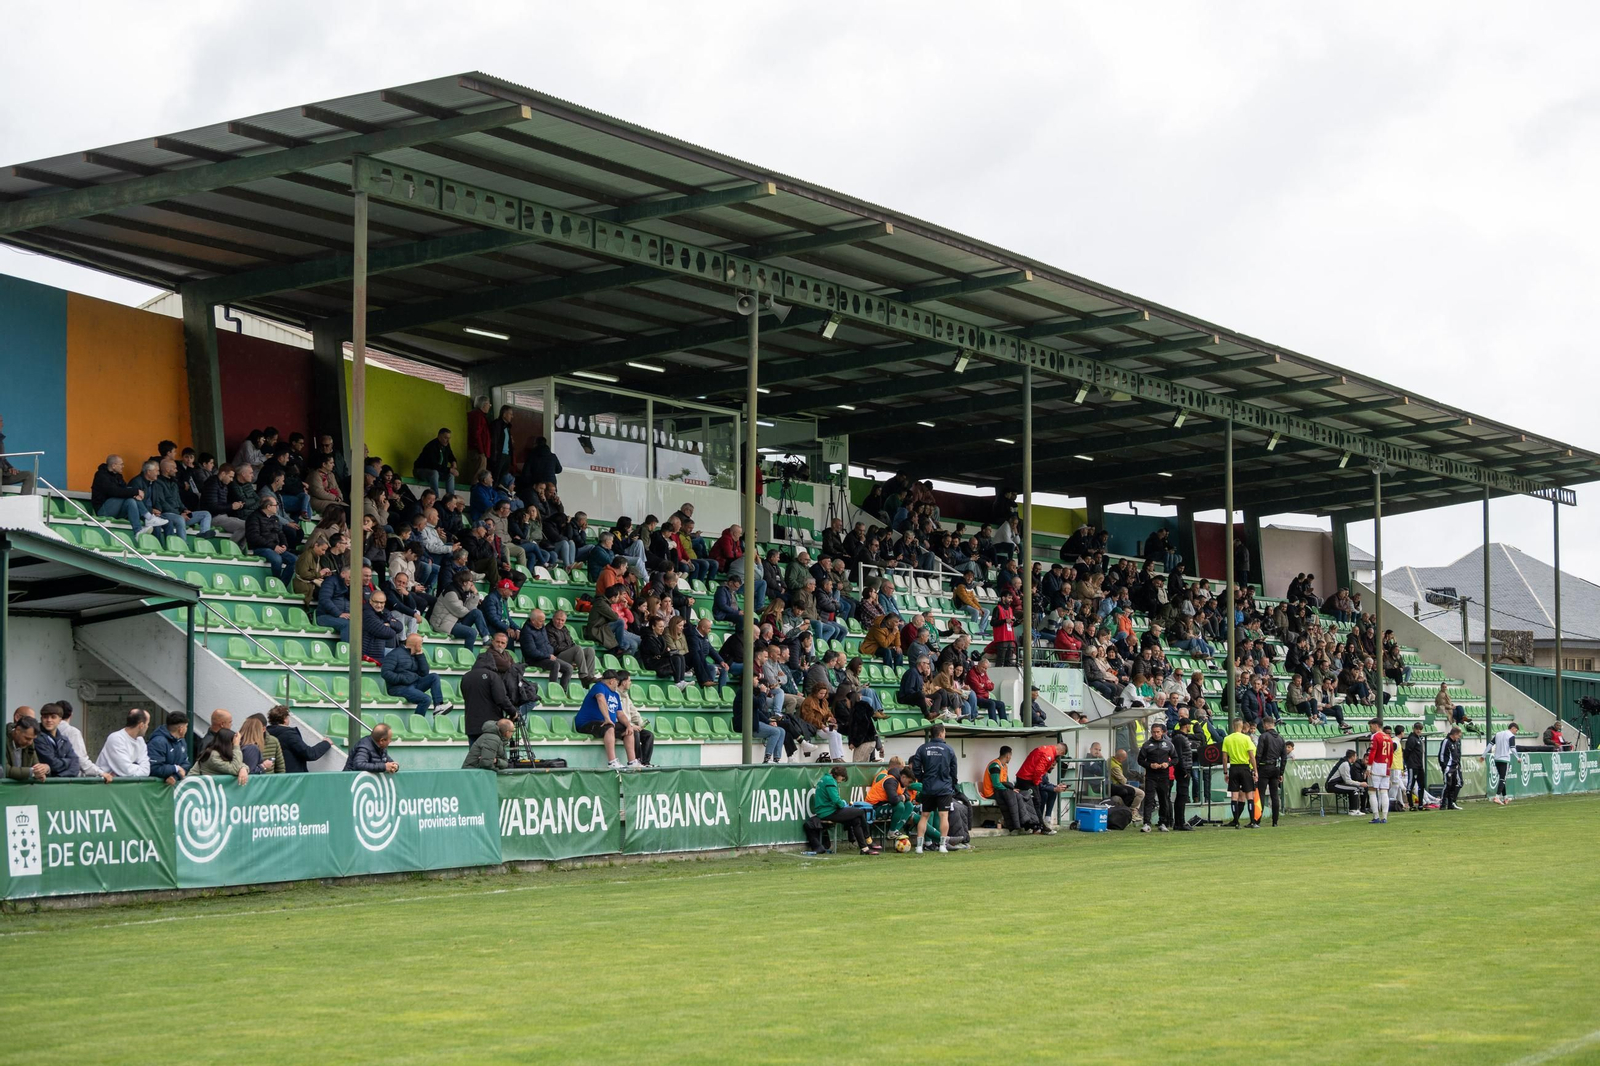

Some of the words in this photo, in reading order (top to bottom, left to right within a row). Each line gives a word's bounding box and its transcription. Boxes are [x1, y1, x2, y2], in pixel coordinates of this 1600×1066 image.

[1381, 741, 1391, 756] 21
[229, 802, 300, 824] ourense
[398, 796, 459, 815] ourense
[756, 788, 816, 822] ABANC
[46, 809, 117, 835] XUNTA
[252, 822, 296, 842] provincia
[298, 820, 330, 836] termal
[418, 814, 457, 832] provincia
[458, 812, 485, 826] termal
[48, 842, 75, 867] DE
[79, 839, 161, 866] GALICIA
